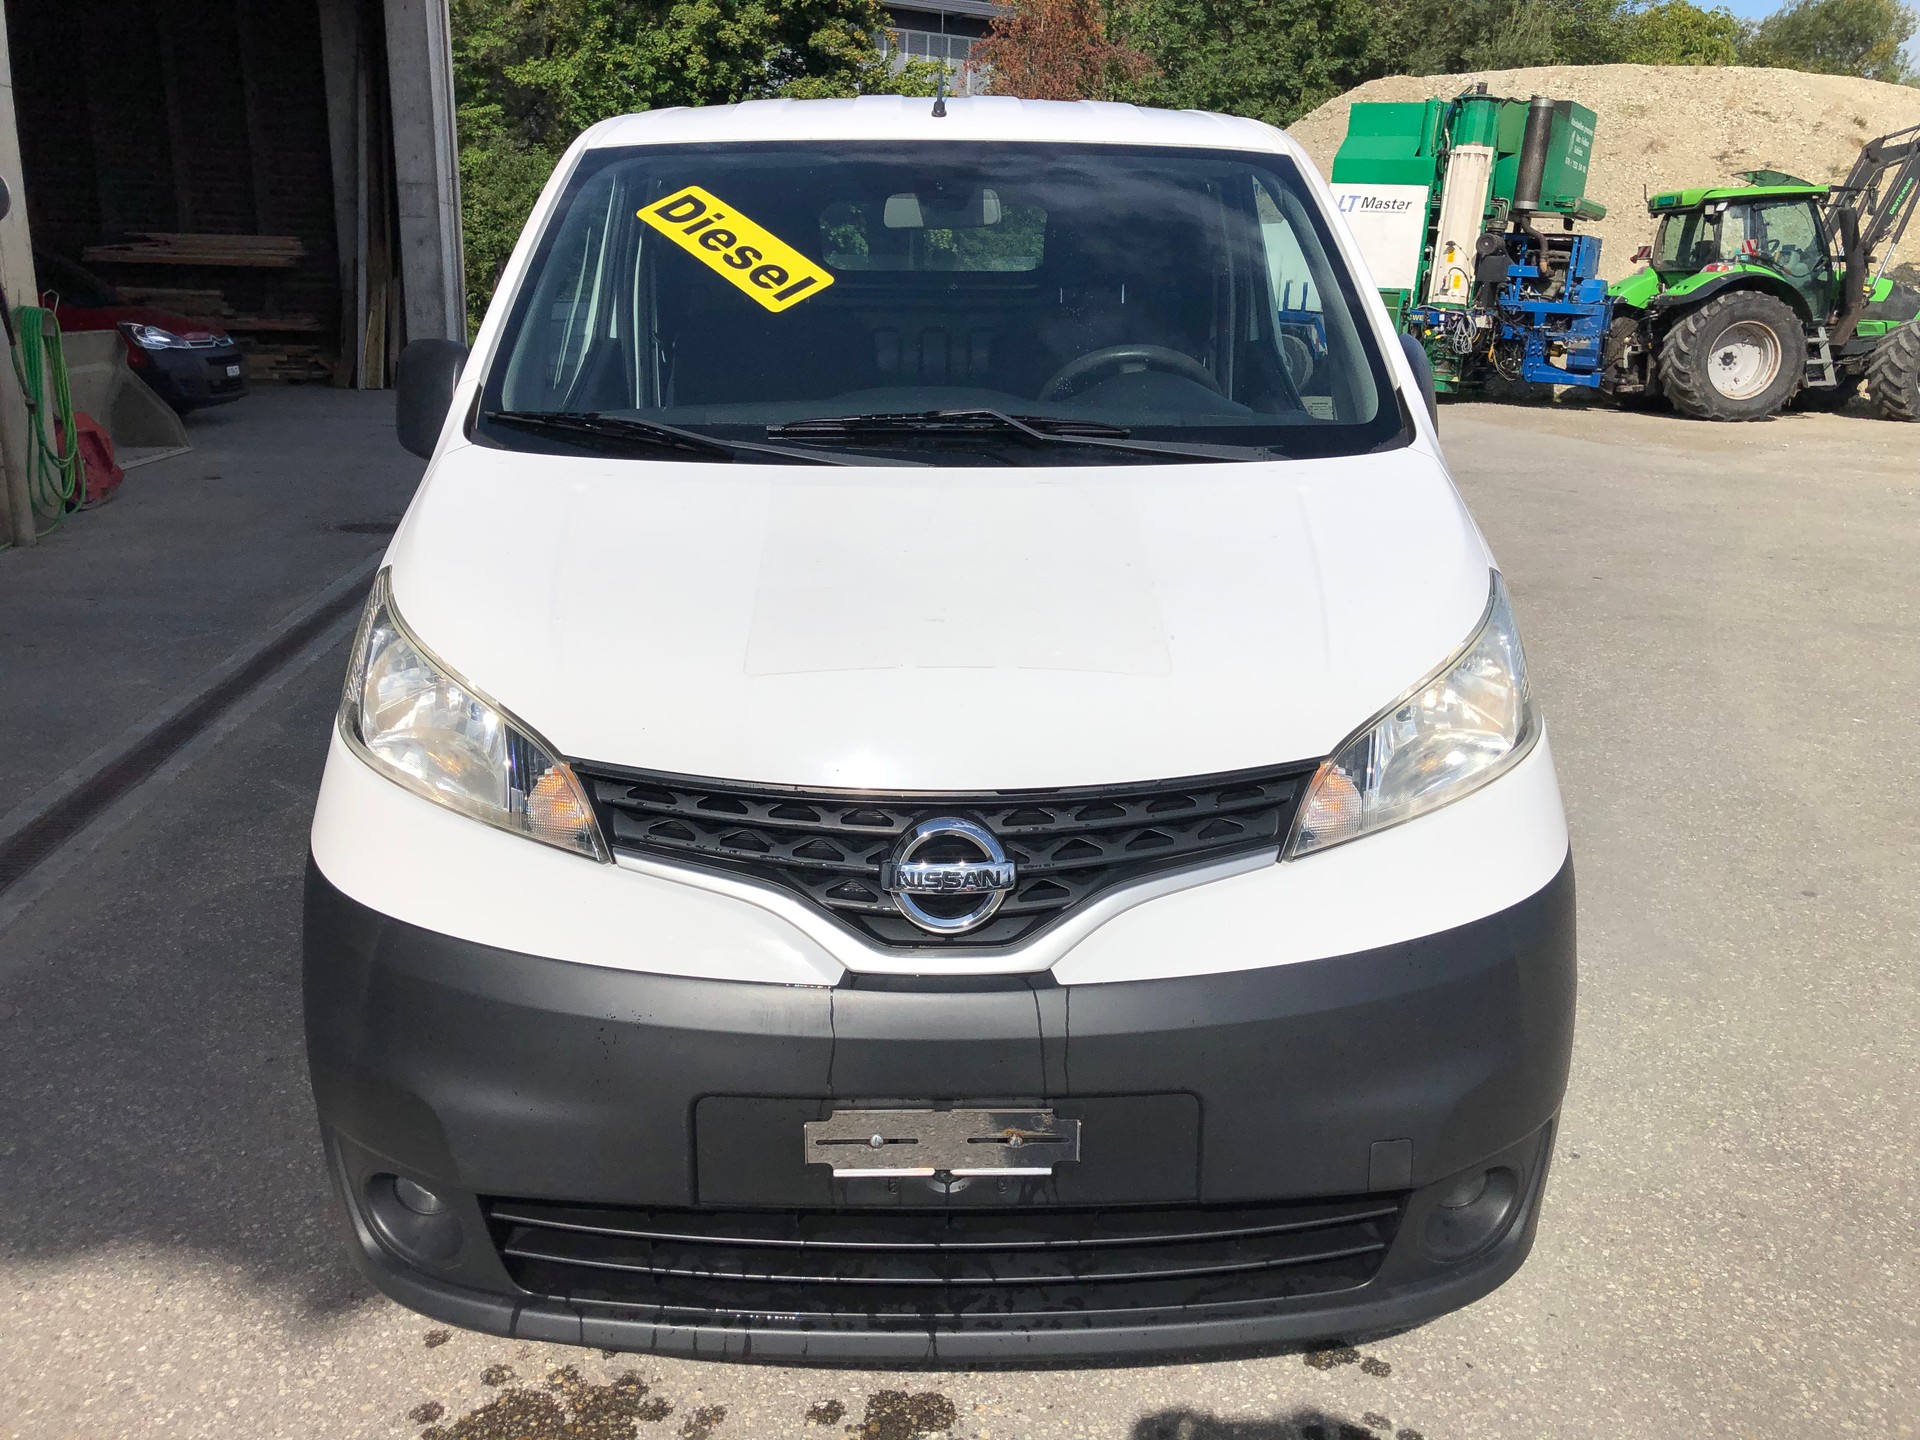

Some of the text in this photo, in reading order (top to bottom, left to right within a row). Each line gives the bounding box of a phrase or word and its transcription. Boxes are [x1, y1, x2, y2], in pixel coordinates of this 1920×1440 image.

[1338, 195, 1412, 212] LT Master
[653, 193, 818, 302] Diesel
[896, 869, 1000, 888] NISSAN
